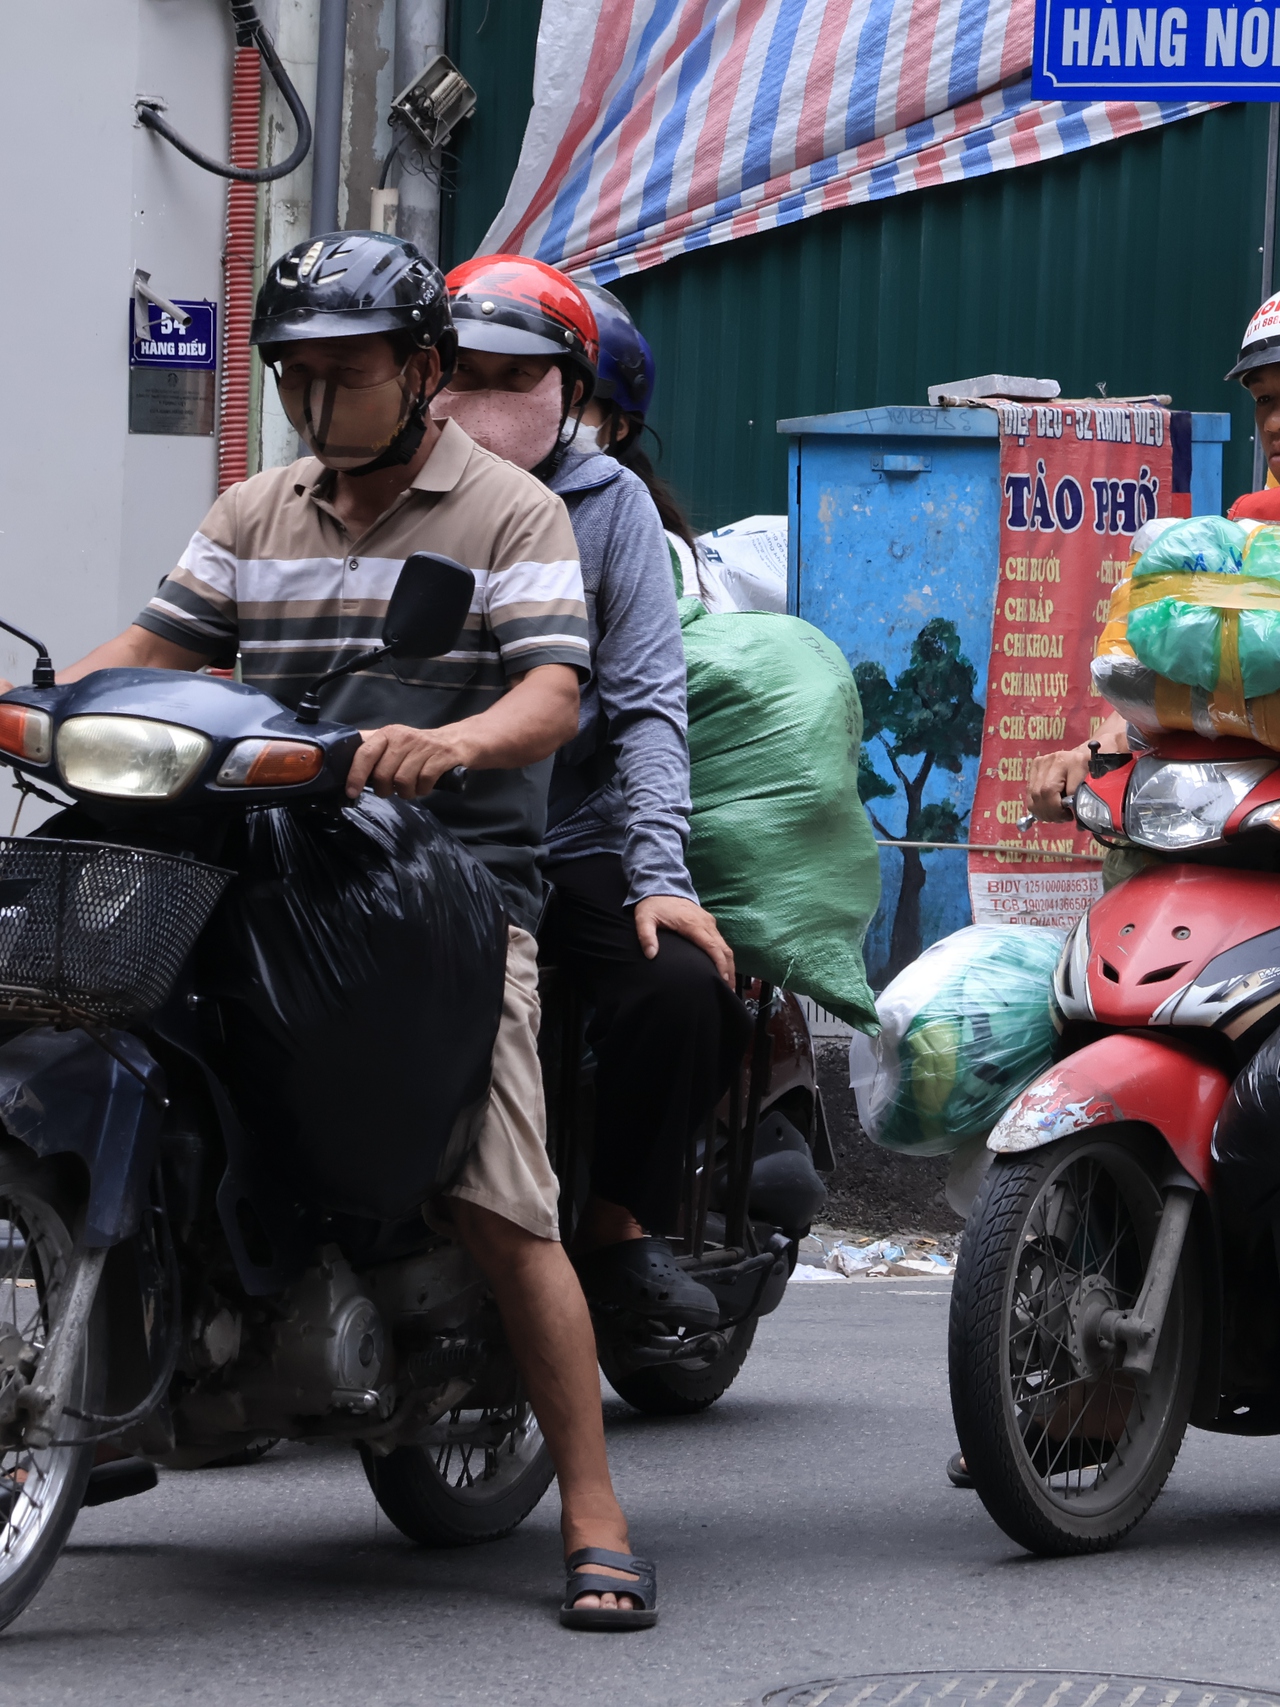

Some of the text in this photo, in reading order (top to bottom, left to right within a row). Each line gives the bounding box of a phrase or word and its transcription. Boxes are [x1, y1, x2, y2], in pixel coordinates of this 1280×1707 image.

[141, 339, 175, 355] HÀNG
[1004, 458, 1085, 535] TÀO
[1025, 634, 1063, 658] KHOAI
[999, 709, 1025, 740] CHÈ
[997, 750, 1022, 781] CHÈ
[987, 880, 1021, 893] BIDV
[990, 898, 1019, 911] TCB
